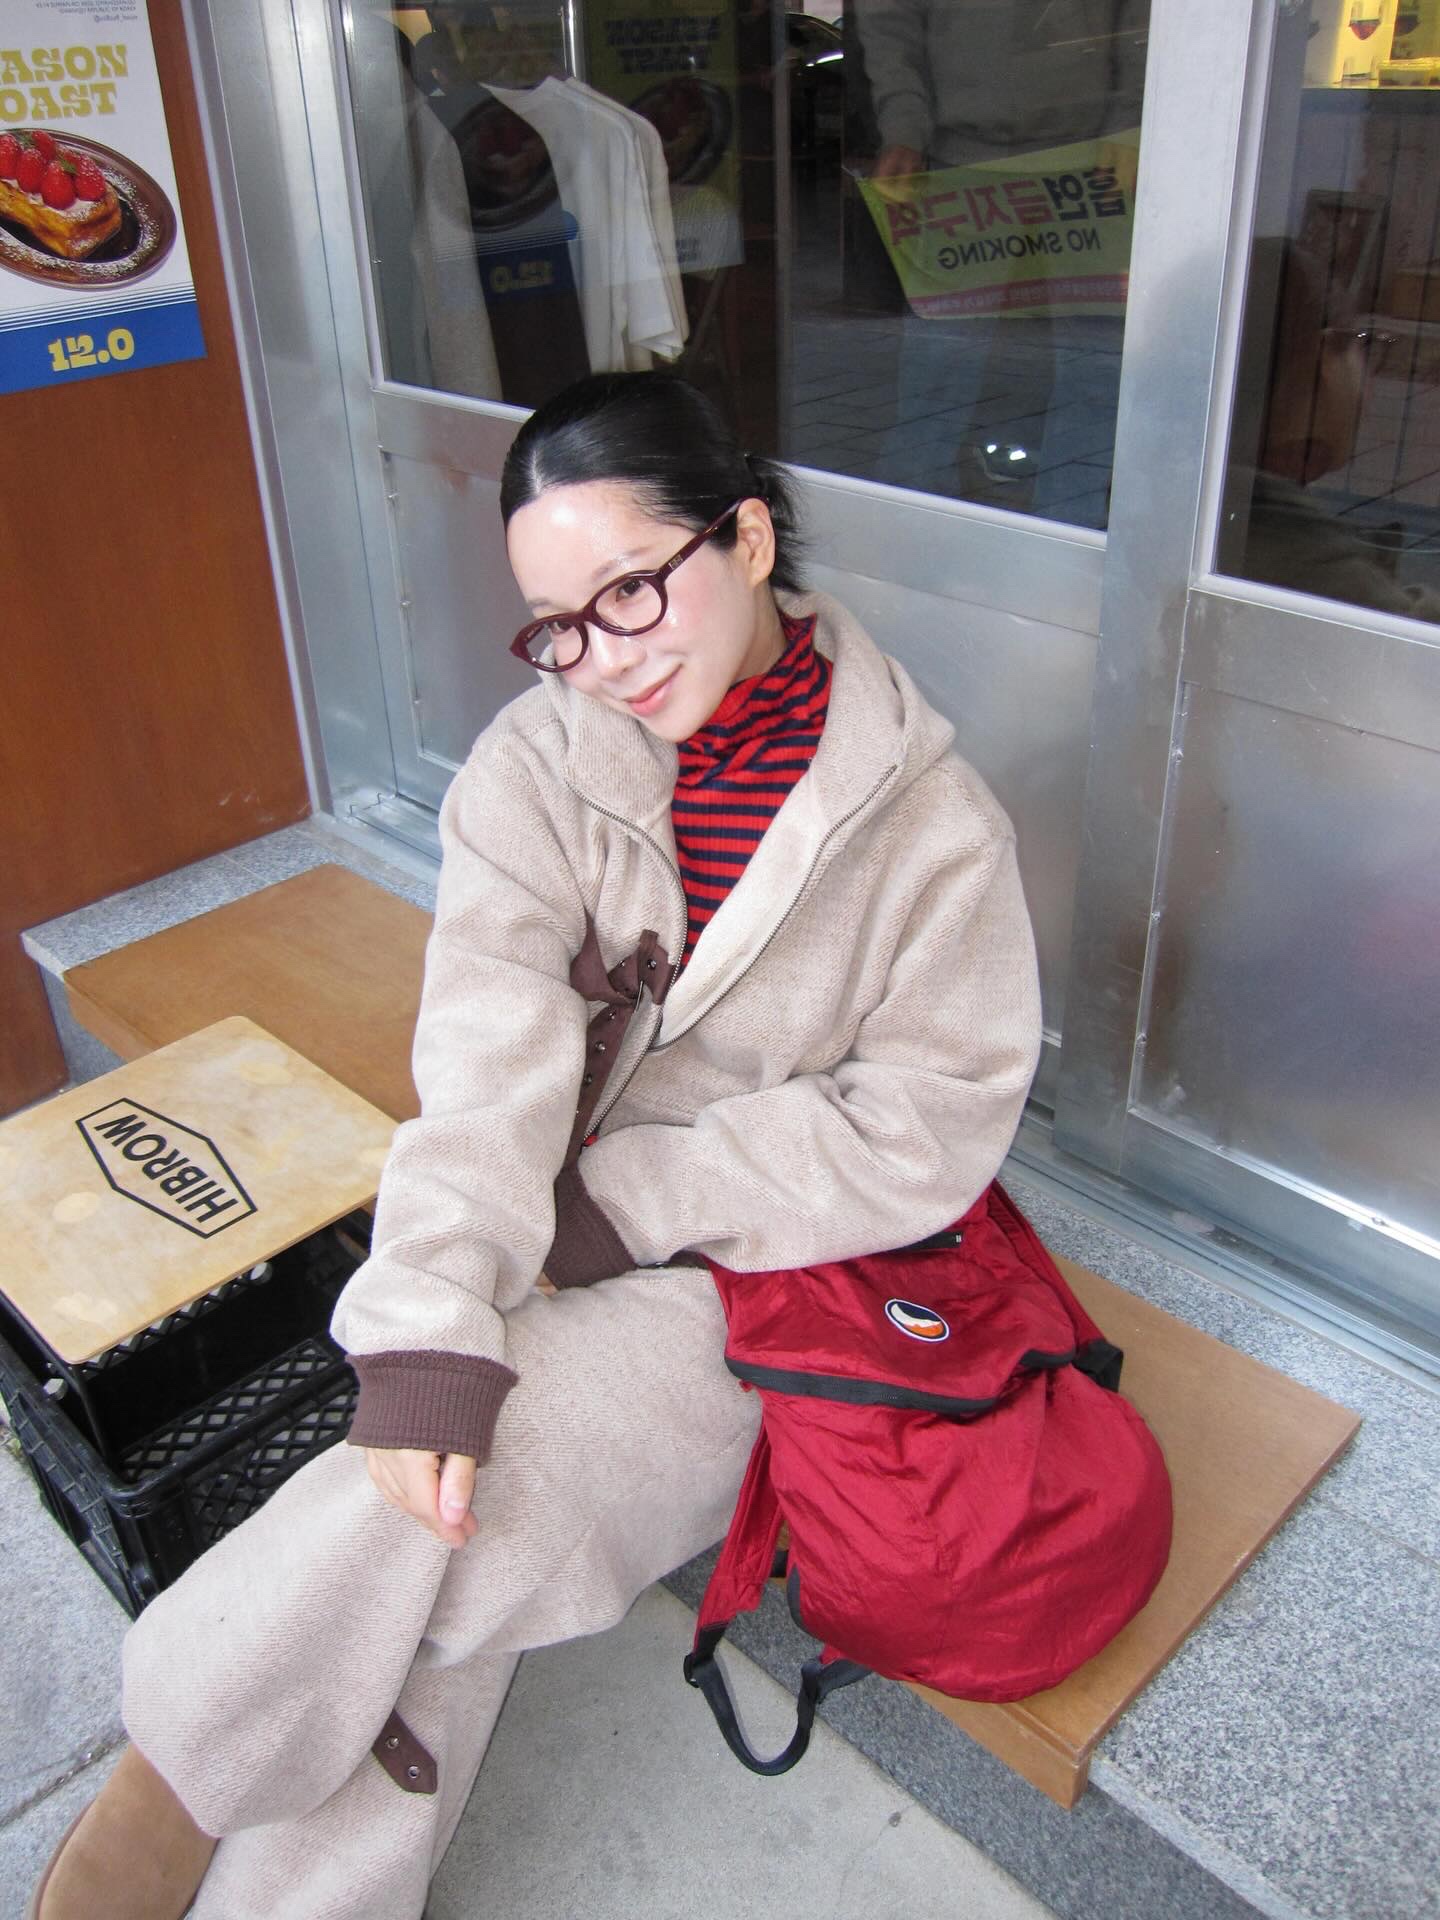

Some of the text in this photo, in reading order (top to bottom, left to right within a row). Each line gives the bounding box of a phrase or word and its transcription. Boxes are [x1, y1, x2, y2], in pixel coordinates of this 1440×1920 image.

[0, 45, 128, 84] ASON
[0, 82, 118, 122] OAST
[48, 328, 135, 371] 12.0
[93, 1113, 239, 1223] HIBROW
